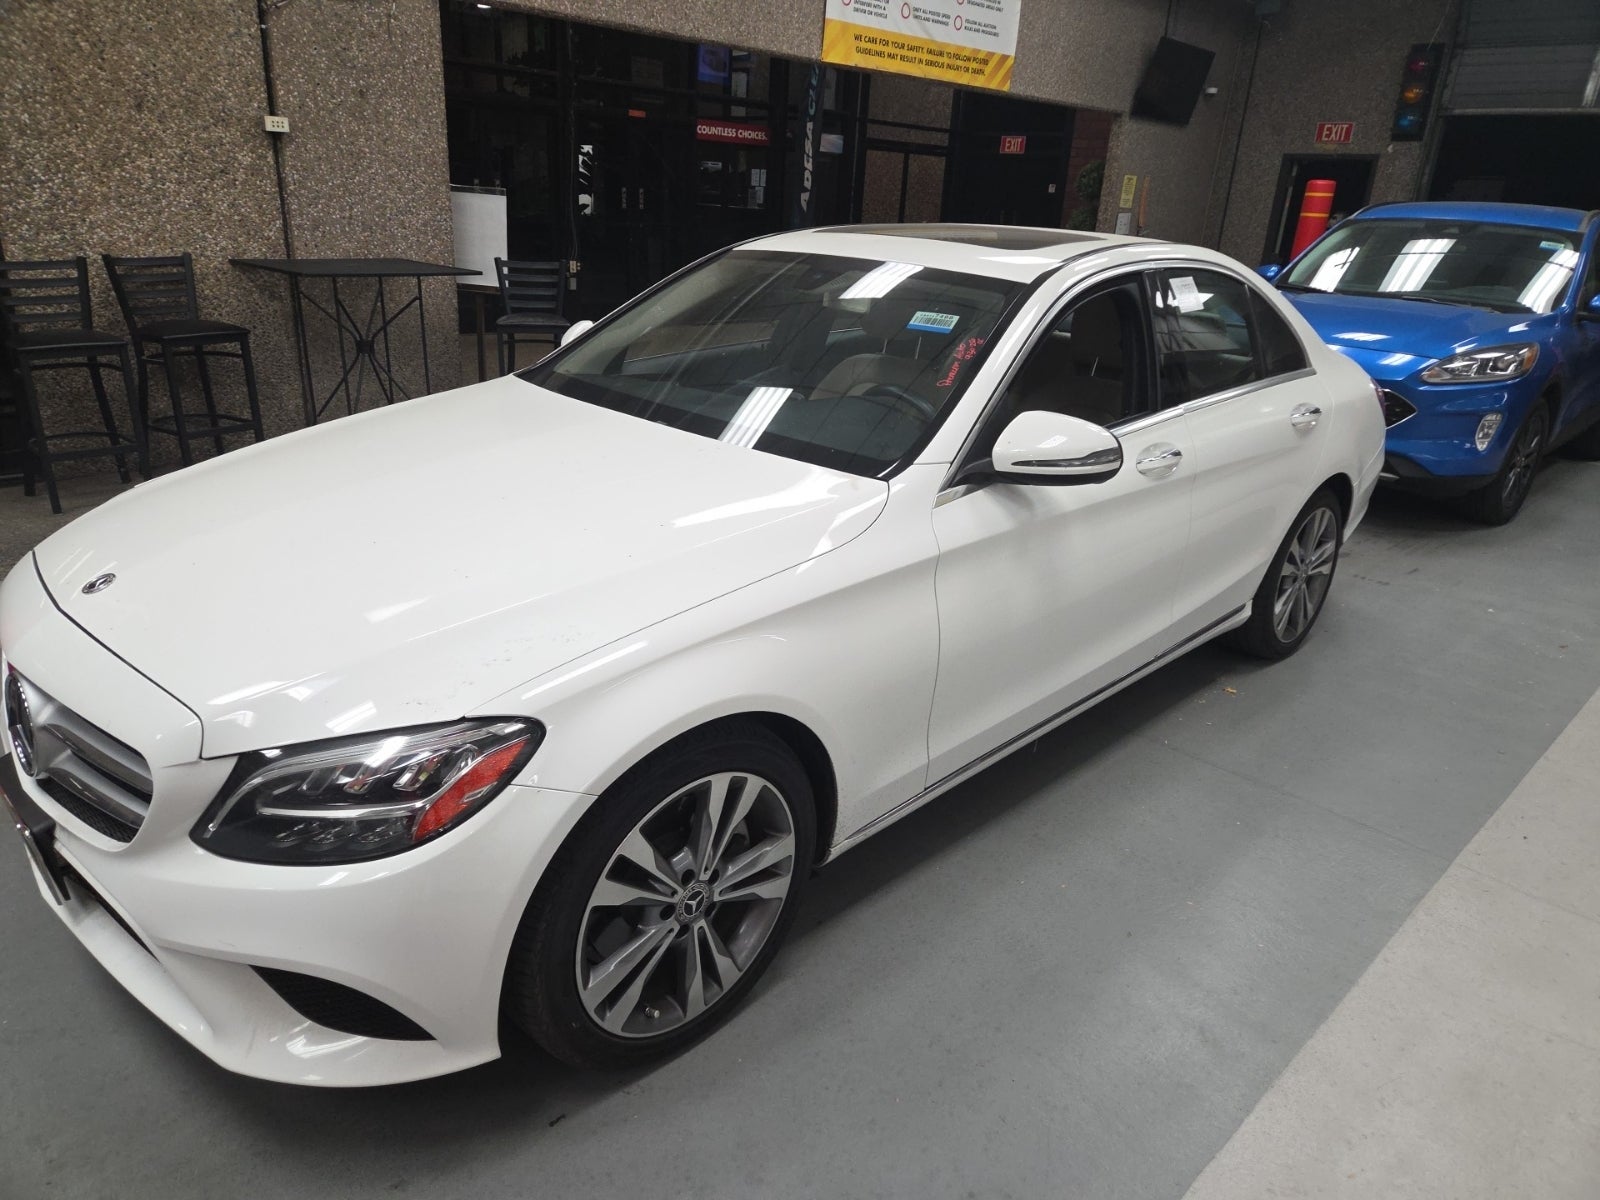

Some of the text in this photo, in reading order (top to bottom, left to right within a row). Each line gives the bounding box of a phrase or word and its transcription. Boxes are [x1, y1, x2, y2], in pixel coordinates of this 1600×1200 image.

[854, 33, 863, 42] WE
[864, 36, 877, 45] CARE
[878, 39, 889, 47] FOR
[891, 41, 906, 50] YOUR
[926, 48, 945, 58] FAILURE
[953, 52, 972, 62] FOLLOW
[972, 56, 989, 66] POSTED
[856, 46, 886, 58] GUIDELINES
[886, 52, 898, 61] MAY
[900, 53, 917, 63] RESULT
[918, 57, 924, 65] IN
[924, 58, 945, 69] SERIOUS
[946, 62, 962, 72] INJURY
[963, 66, 970, 74] OR
[696, 124, 768, 141] COUNTLESS CHOICES.
[1322, 124, 1349, 141] EXIT
[1005, 138, 1022, 152] EXIT
[800, 121, 814, 212] ADESA
